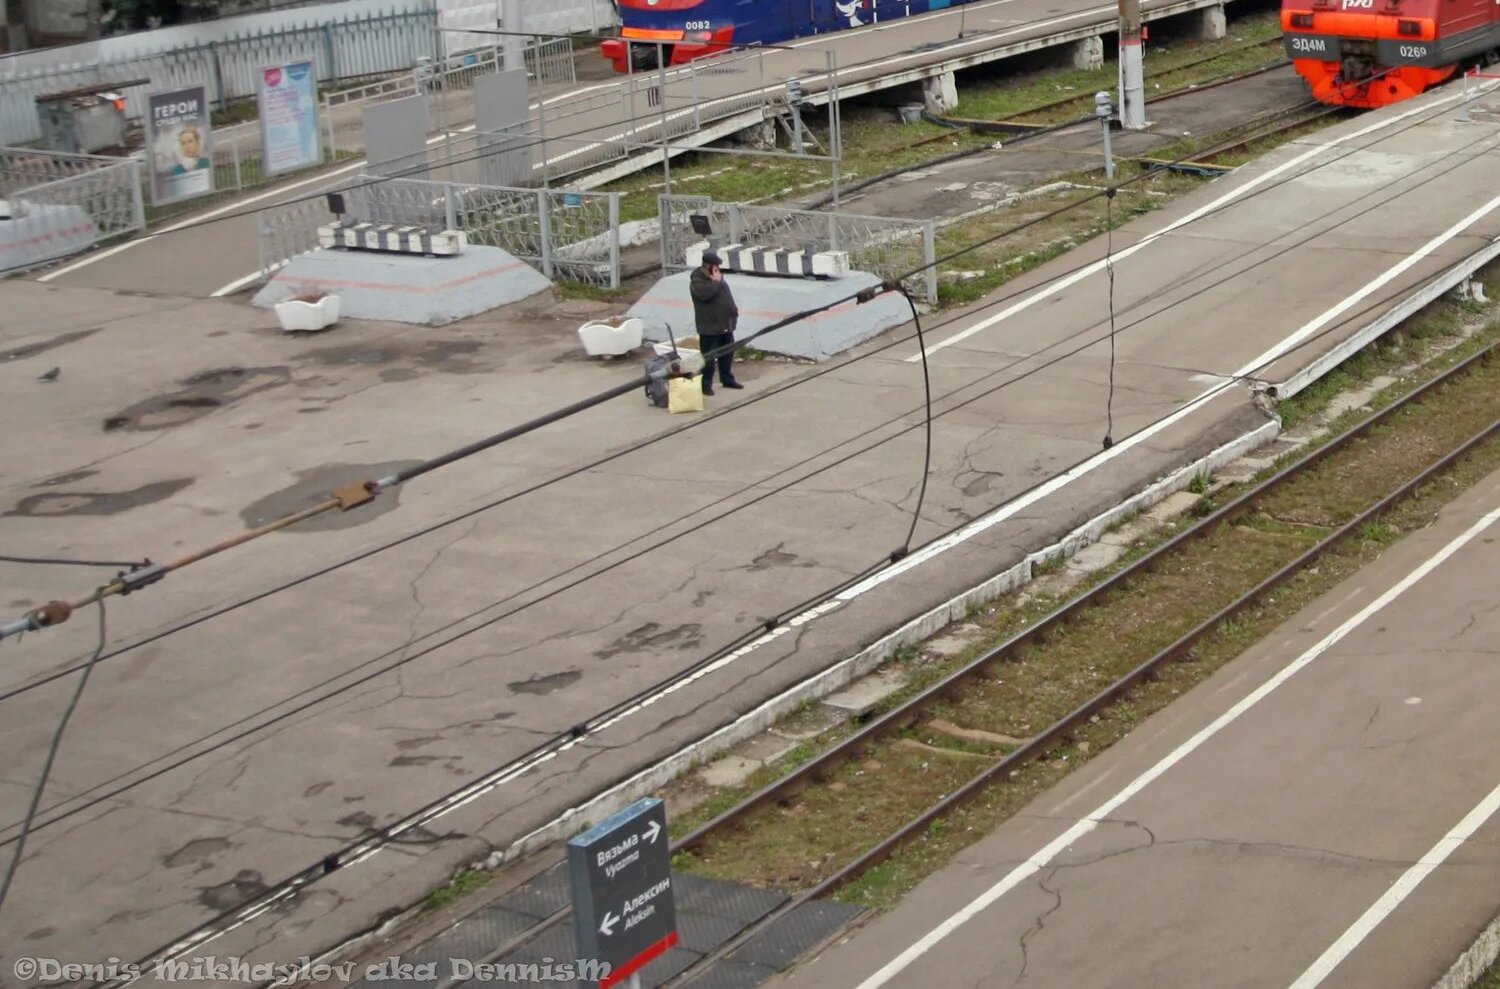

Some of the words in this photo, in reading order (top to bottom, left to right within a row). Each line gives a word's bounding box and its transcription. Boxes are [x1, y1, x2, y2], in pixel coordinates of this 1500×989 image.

[685, 21, 710, 30] 0082
[1292, 38, 1326, 52] ЭД4М
[1400, 46, 1427, 58] 0269
[155, 99, 198, 119] ГЕРОИ
[597, 834, 639, 867] Вязьма
[605, 850, 640, 878] Vyazma
[623, 877, 670, 917] Алексин
[624, 904, 655, 932] Aleksin
